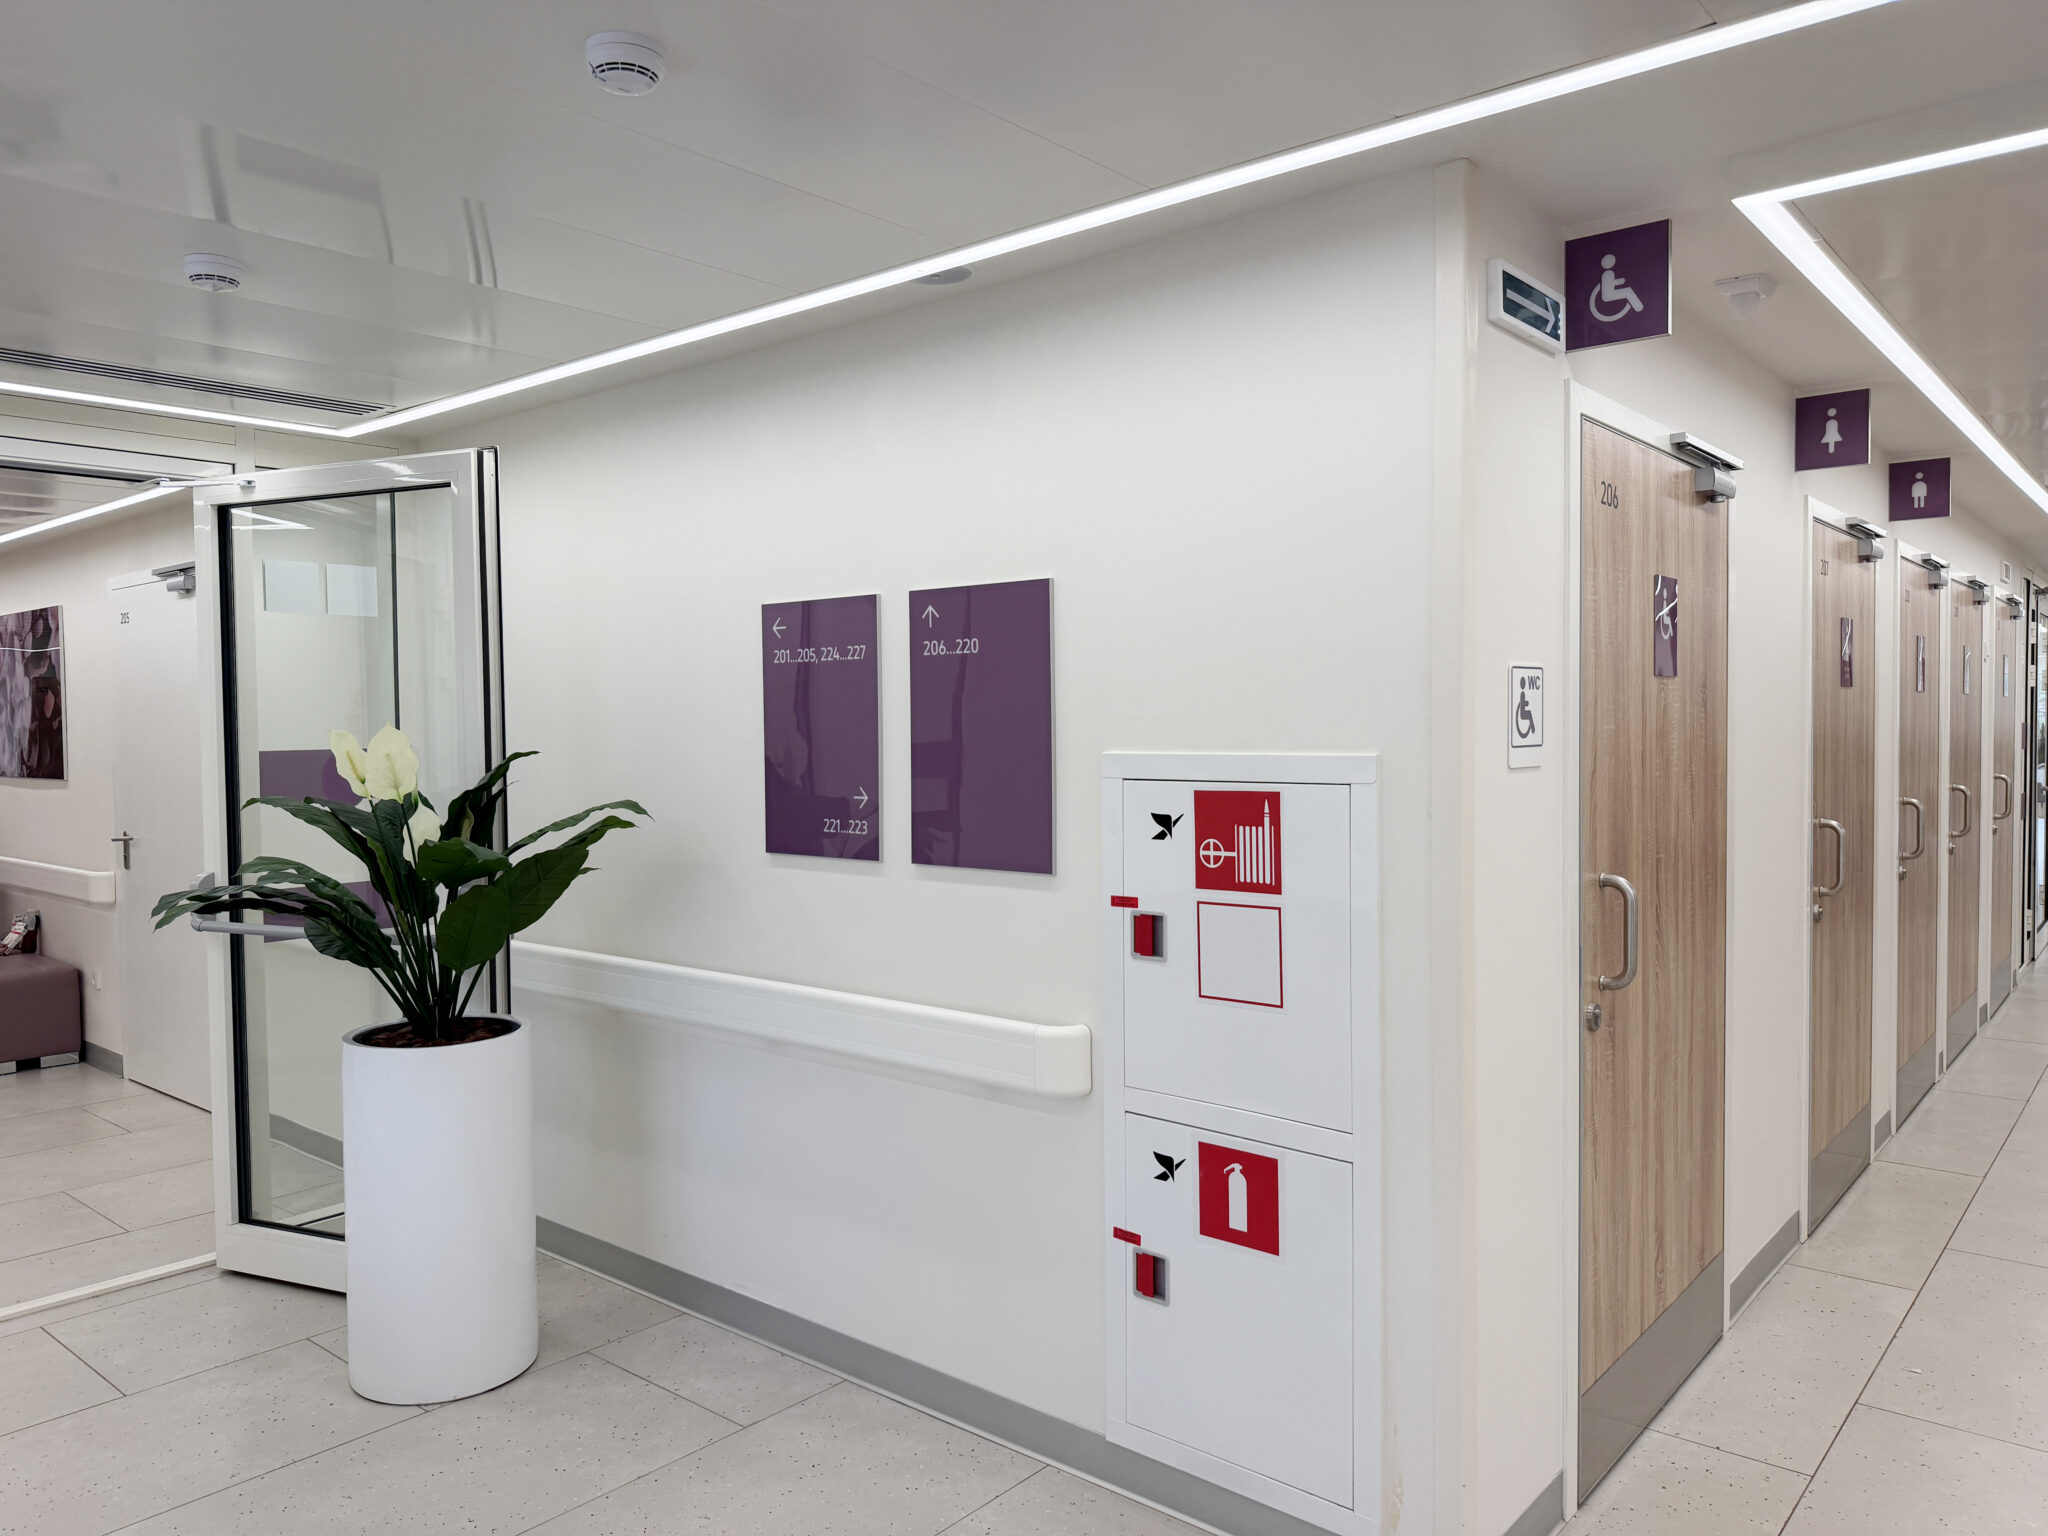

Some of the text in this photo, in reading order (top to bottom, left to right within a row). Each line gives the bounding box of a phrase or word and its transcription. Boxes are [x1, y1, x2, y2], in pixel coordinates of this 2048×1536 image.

[1600, 480, 1619, 509] 206
[120, 612, 130, 624] 205
[773, 645, 866, 664] 201...205, 224...227
[923, 638, 979, 656] 206...220
[1527, 675, 1541, 690] WC
[823, 818, 868, 835] 221...223
